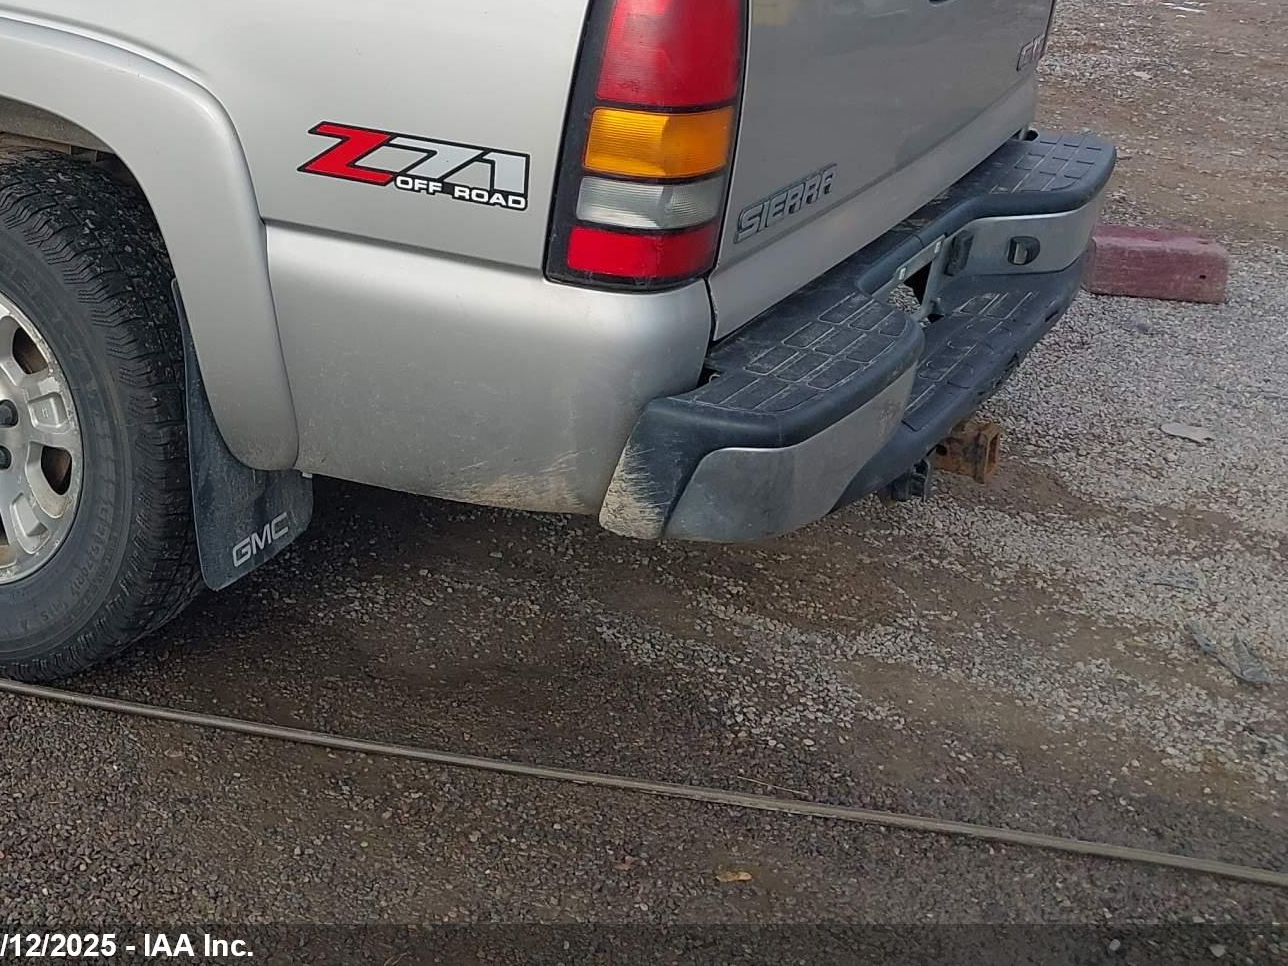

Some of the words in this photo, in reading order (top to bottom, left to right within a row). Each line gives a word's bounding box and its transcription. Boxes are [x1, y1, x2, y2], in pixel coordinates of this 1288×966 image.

[297, 121, 531, 196] Z71
[394, 175, 443, 195] OFF
[453, 186, 527, 211] ROAD
[733, 163, 838, 244] SIERRA
[232, 511, 289, 568] GMC
